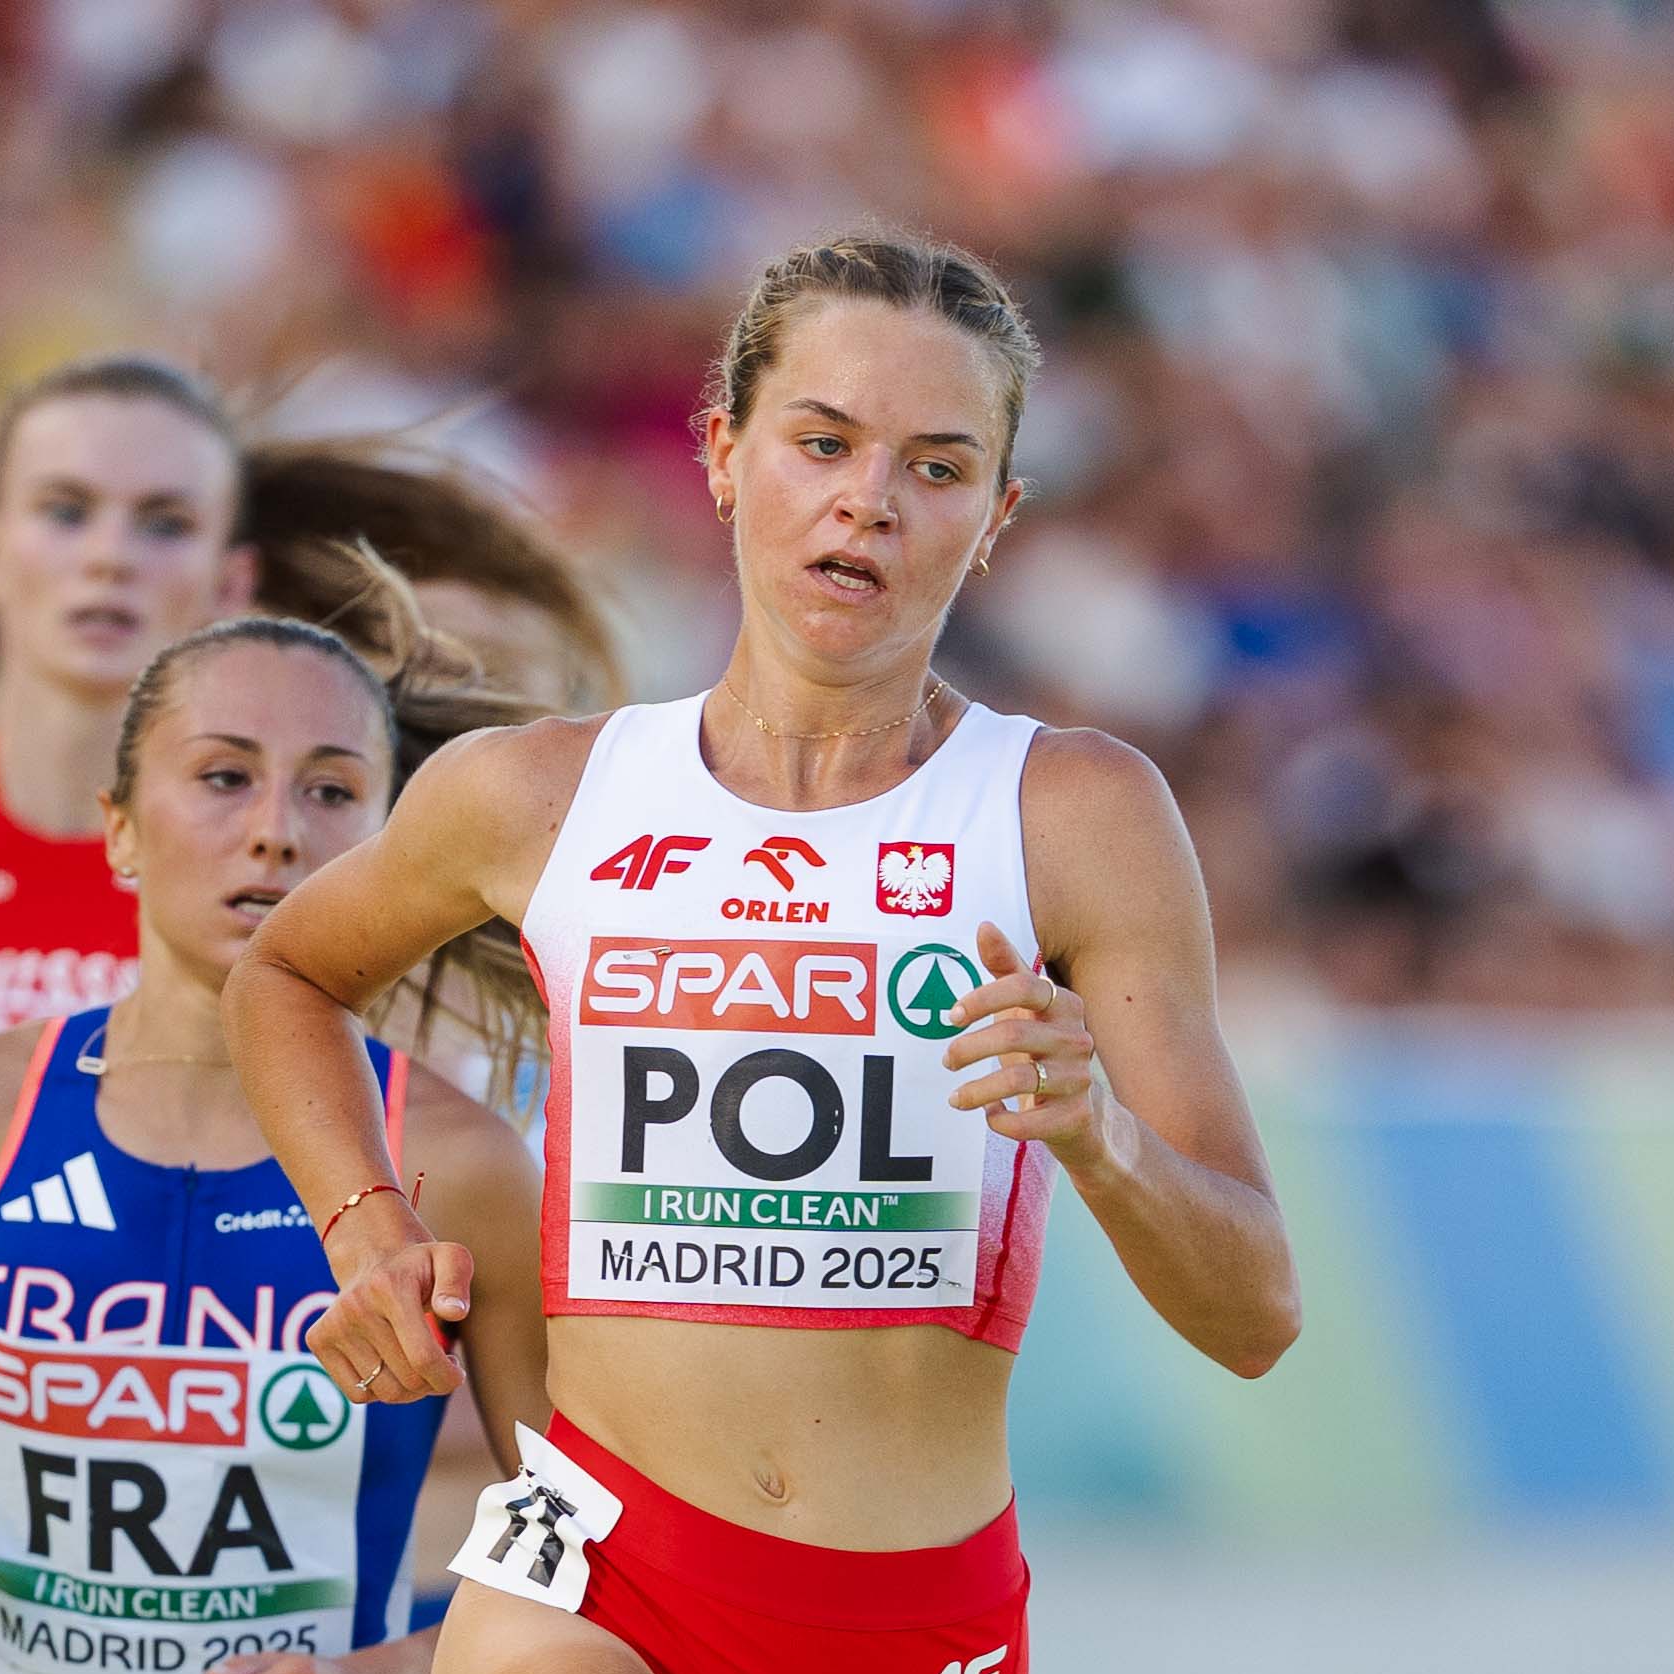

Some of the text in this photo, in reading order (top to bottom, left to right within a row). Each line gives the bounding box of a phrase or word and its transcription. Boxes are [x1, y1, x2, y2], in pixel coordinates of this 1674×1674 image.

[590, 834, 712, 890] 4F
[721, 898, 830, 923] ORLEN
[588, 948, 867, 1022] SPAR
[620, 1045, 934, 1183] POL
[642, 1188, 652, 1219] I
[659, 1189, 741, 1223] RUN
[600, 1238, 942, 1290] MADRID 2025
[19, 1445, 294, 1577] FRA
[34, 1572, 47, 1600] I
[51, 1576, 125, 1616] RUN
[0, 1605, 186, 1672] MADRID
